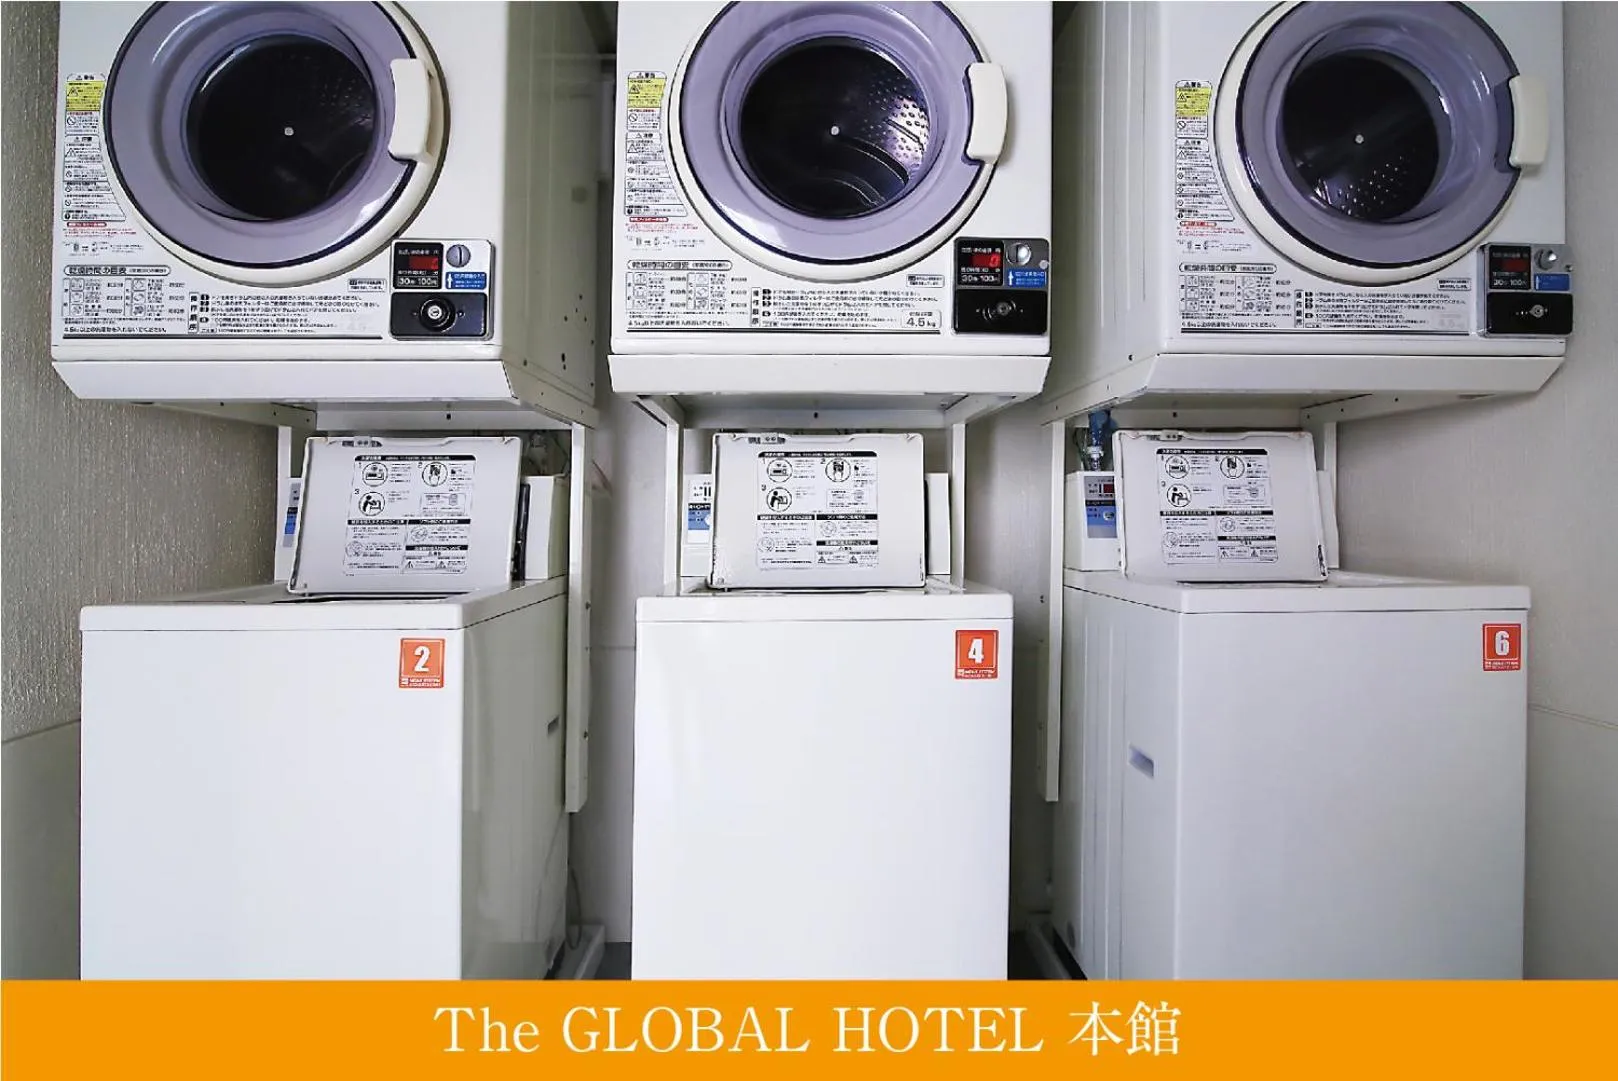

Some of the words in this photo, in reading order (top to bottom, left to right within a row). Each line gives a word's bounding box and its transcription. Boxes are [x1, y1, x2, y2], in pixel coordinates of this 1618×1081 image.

[968, 638, 984, 664] 4
[1495, 630, 1510, 656] 6
[414, 645, 430, 672] 2
